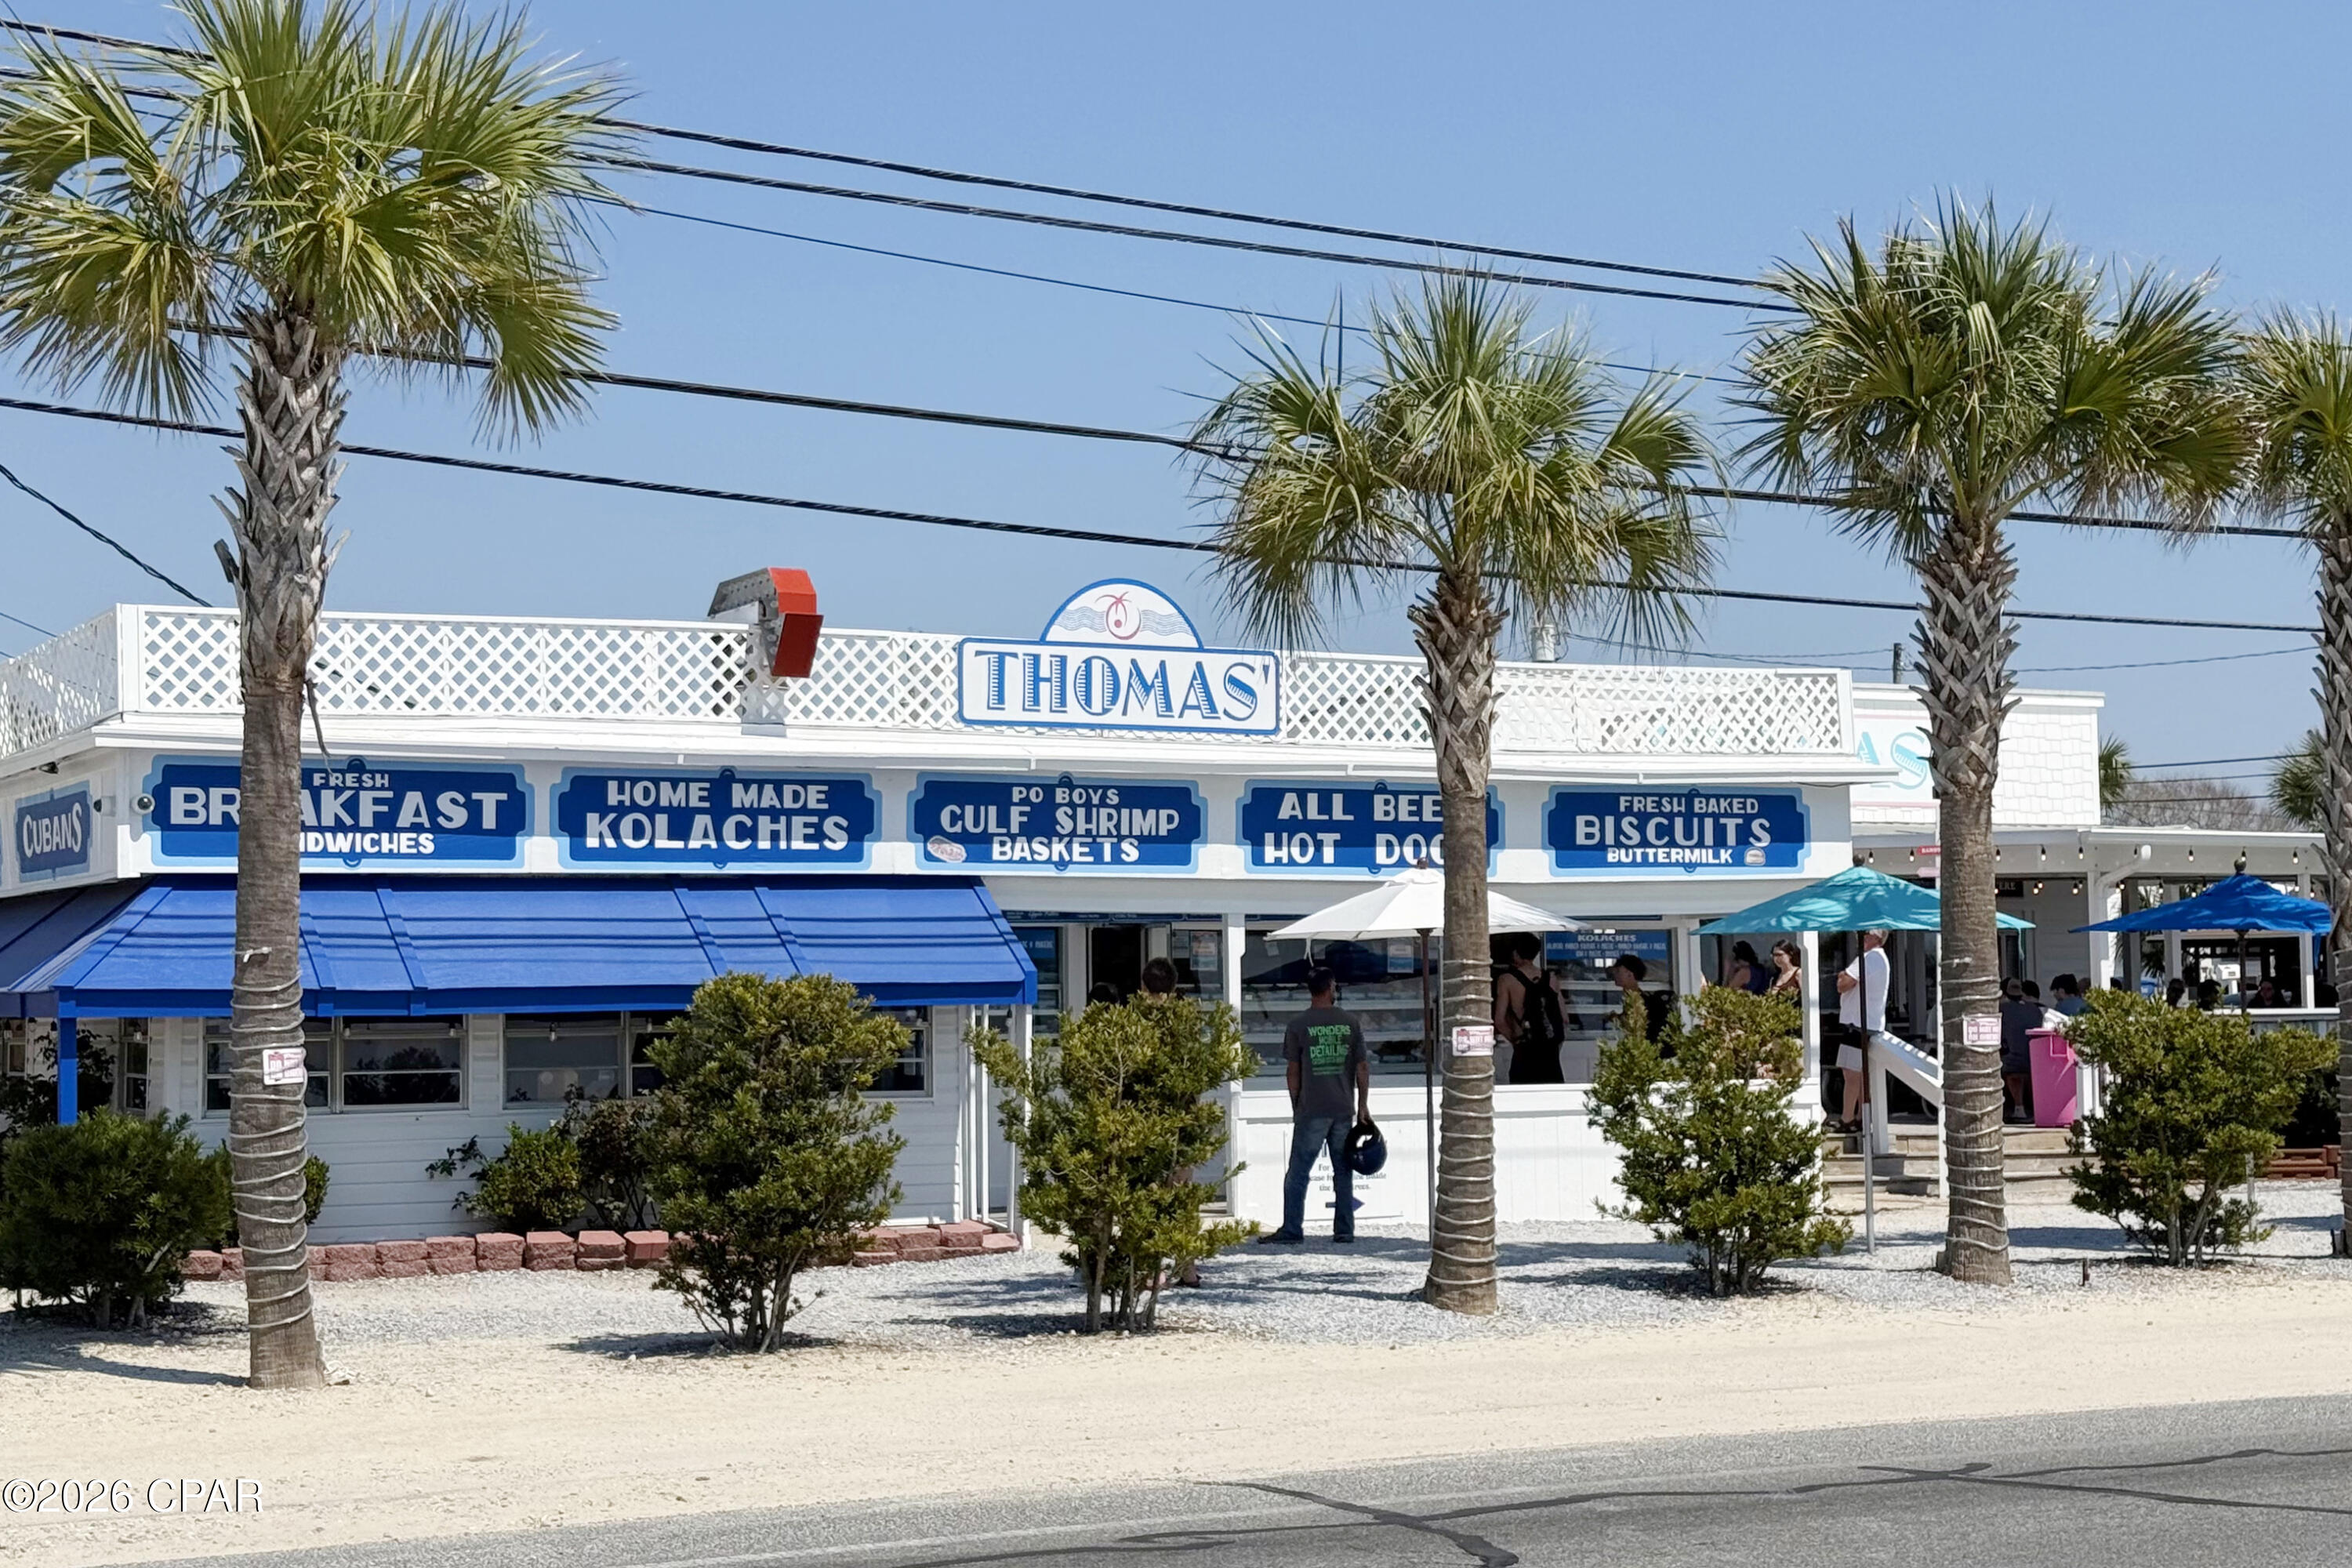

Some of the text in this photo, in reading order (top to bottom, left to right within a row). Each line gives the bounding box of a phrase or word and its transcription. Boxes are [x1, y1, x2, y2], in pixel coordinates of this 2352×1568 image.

[975, 651, 1270, 722] THOMAS'
[313, 772, 390, 788] FRESH
[607, 780, 829, 810] HOME MADE
[170, 786, 509, 830] BRAKFAST
[1012, 786, 1120, 805] PO BOYS
[1278, 792, 1445, 822] ALL BEE
[1619, 795, 1759, 815] FRESH BAKED
[23, 802, 82, 858] CUBANS
[586, 812, 849, 851] KOLACHES
[941, 804, 1179, 837] GULF SHRIMP
[1575, 815, 1772, 848] BISCUITS
[992, 836, 1140, 862] BASKETS
[1264, 832, 1341, 865] HOT
[1607, 847, 1733, 865] BUTTERMILK
[1307, 1025, 1352, 1036] WONDERS
